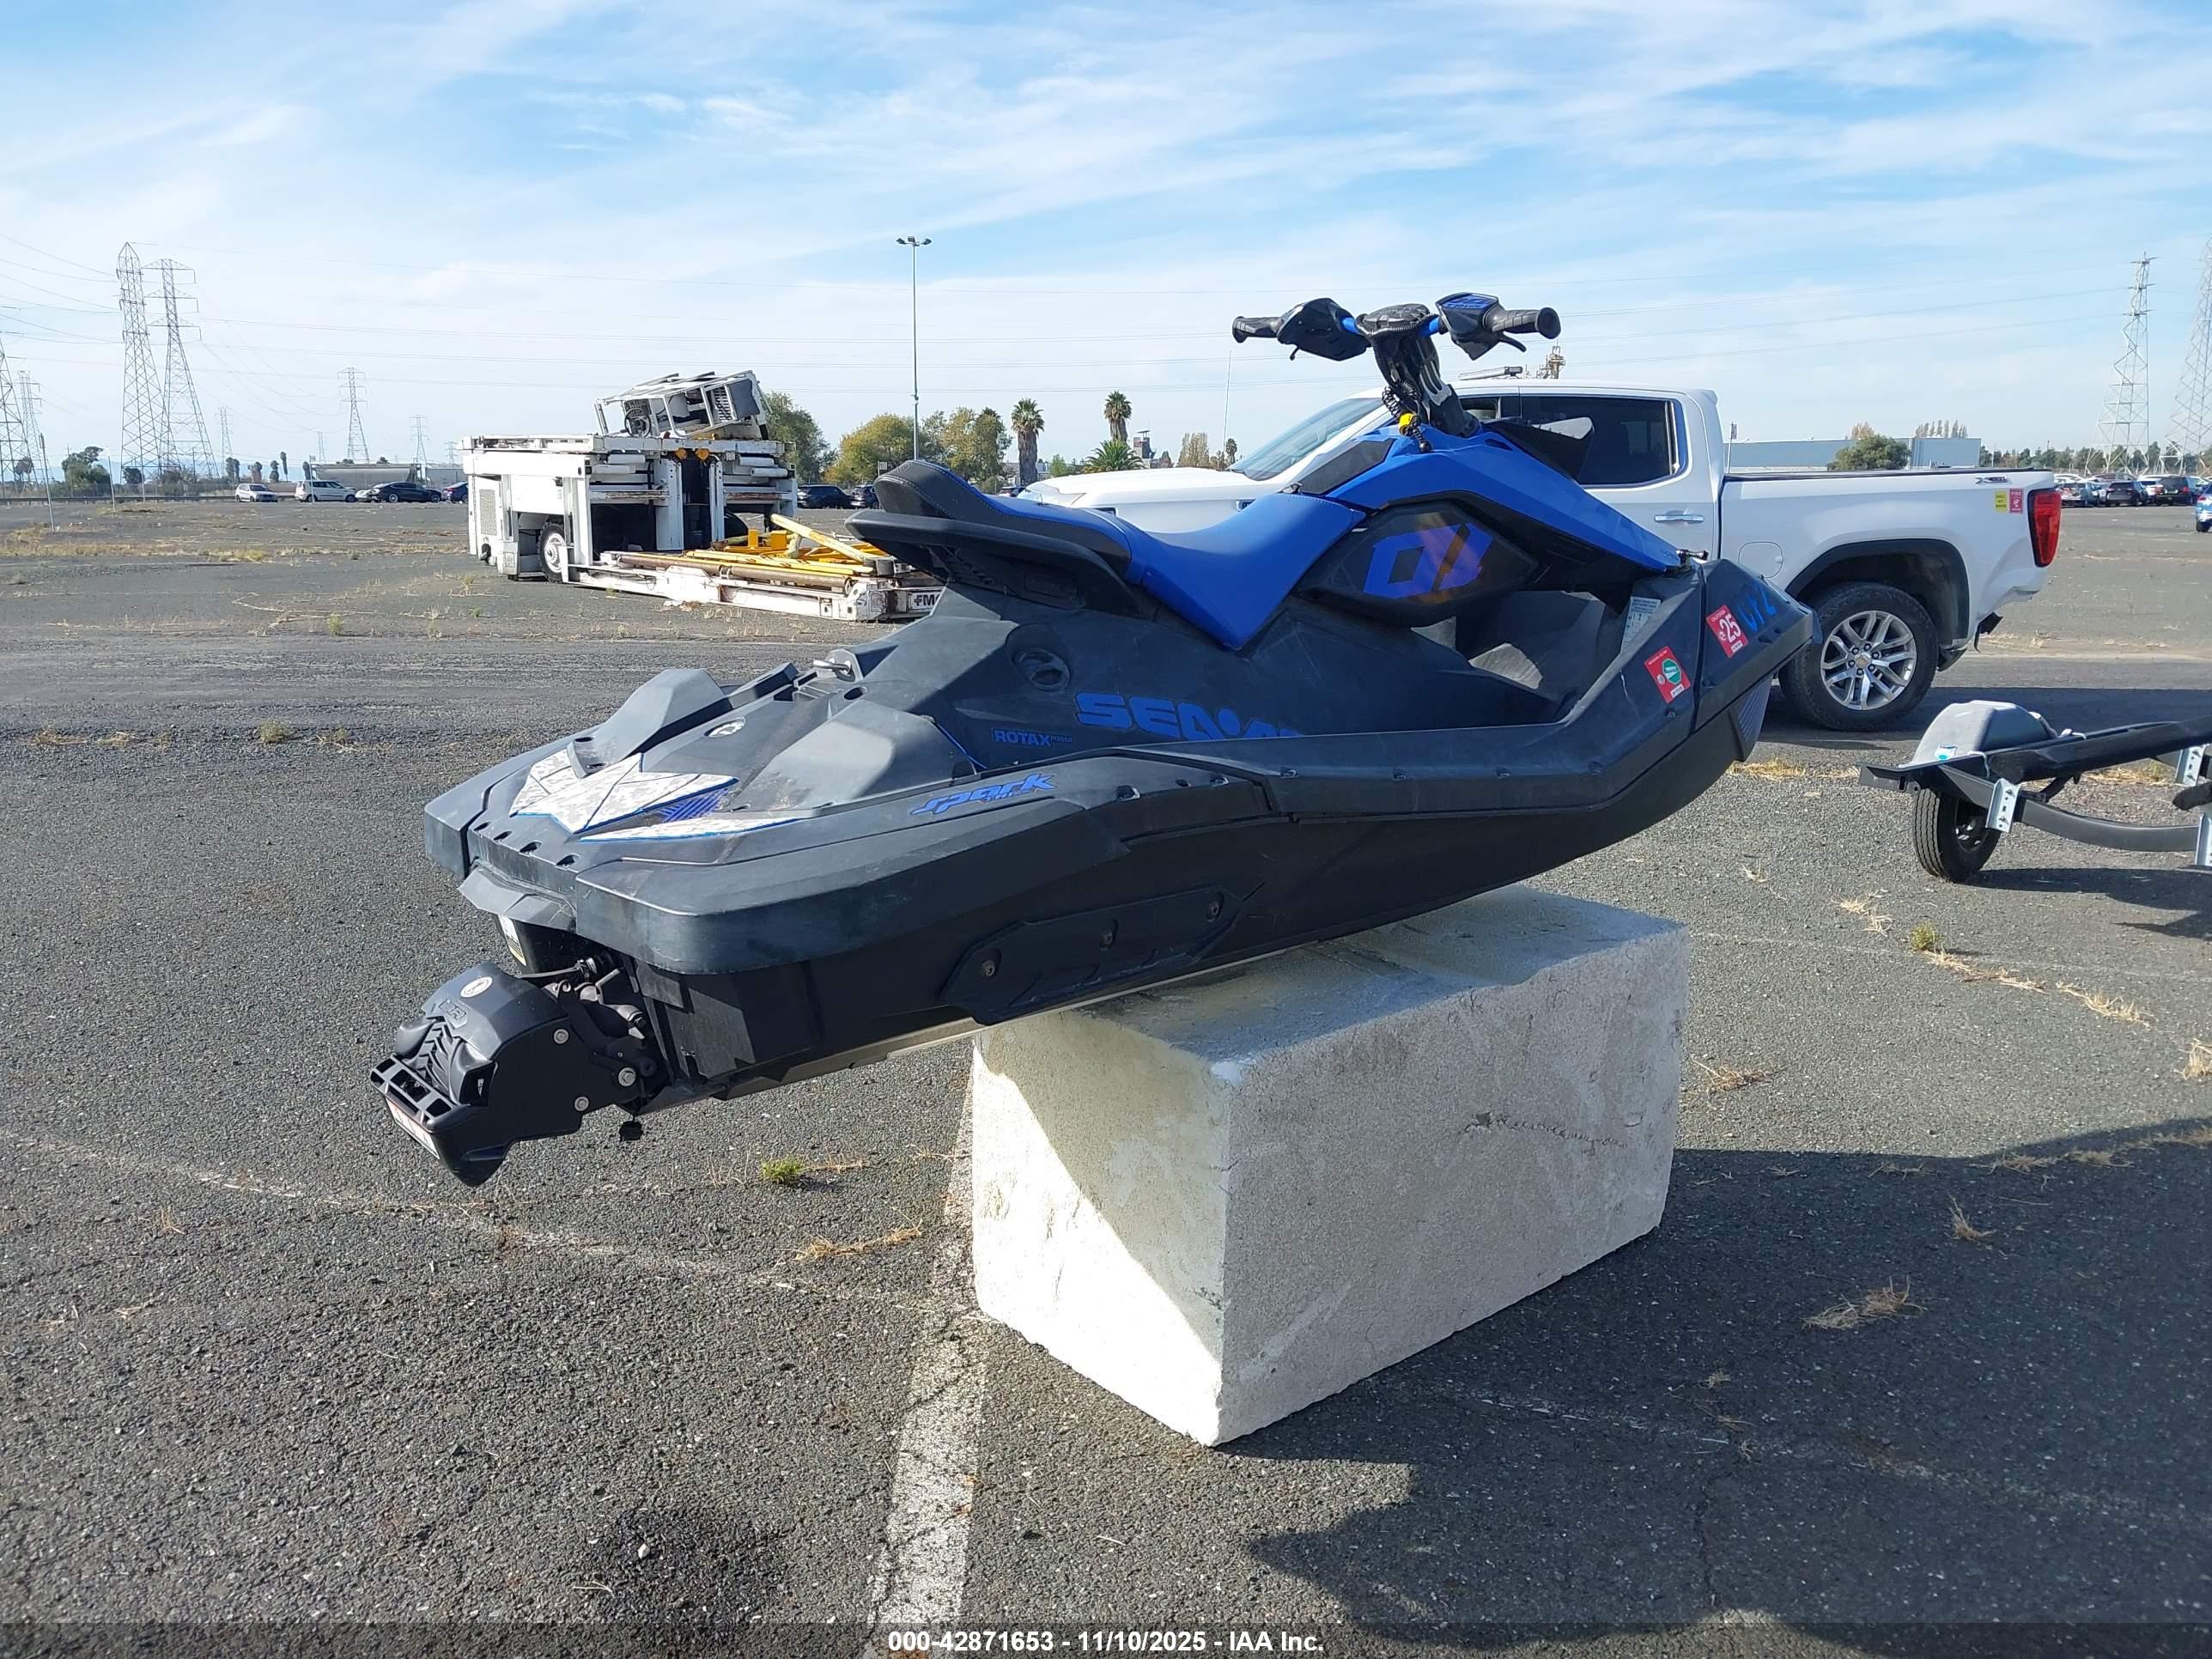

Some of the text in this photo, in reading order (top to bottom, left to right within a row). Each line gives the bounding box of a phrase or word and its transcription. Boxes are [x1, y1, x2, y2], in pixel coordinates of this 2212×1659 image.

[914, 593, 940, 606] FM
[1719, 613, 1741, 643] 25
[994, 730, 1051, 747] ROTAX
